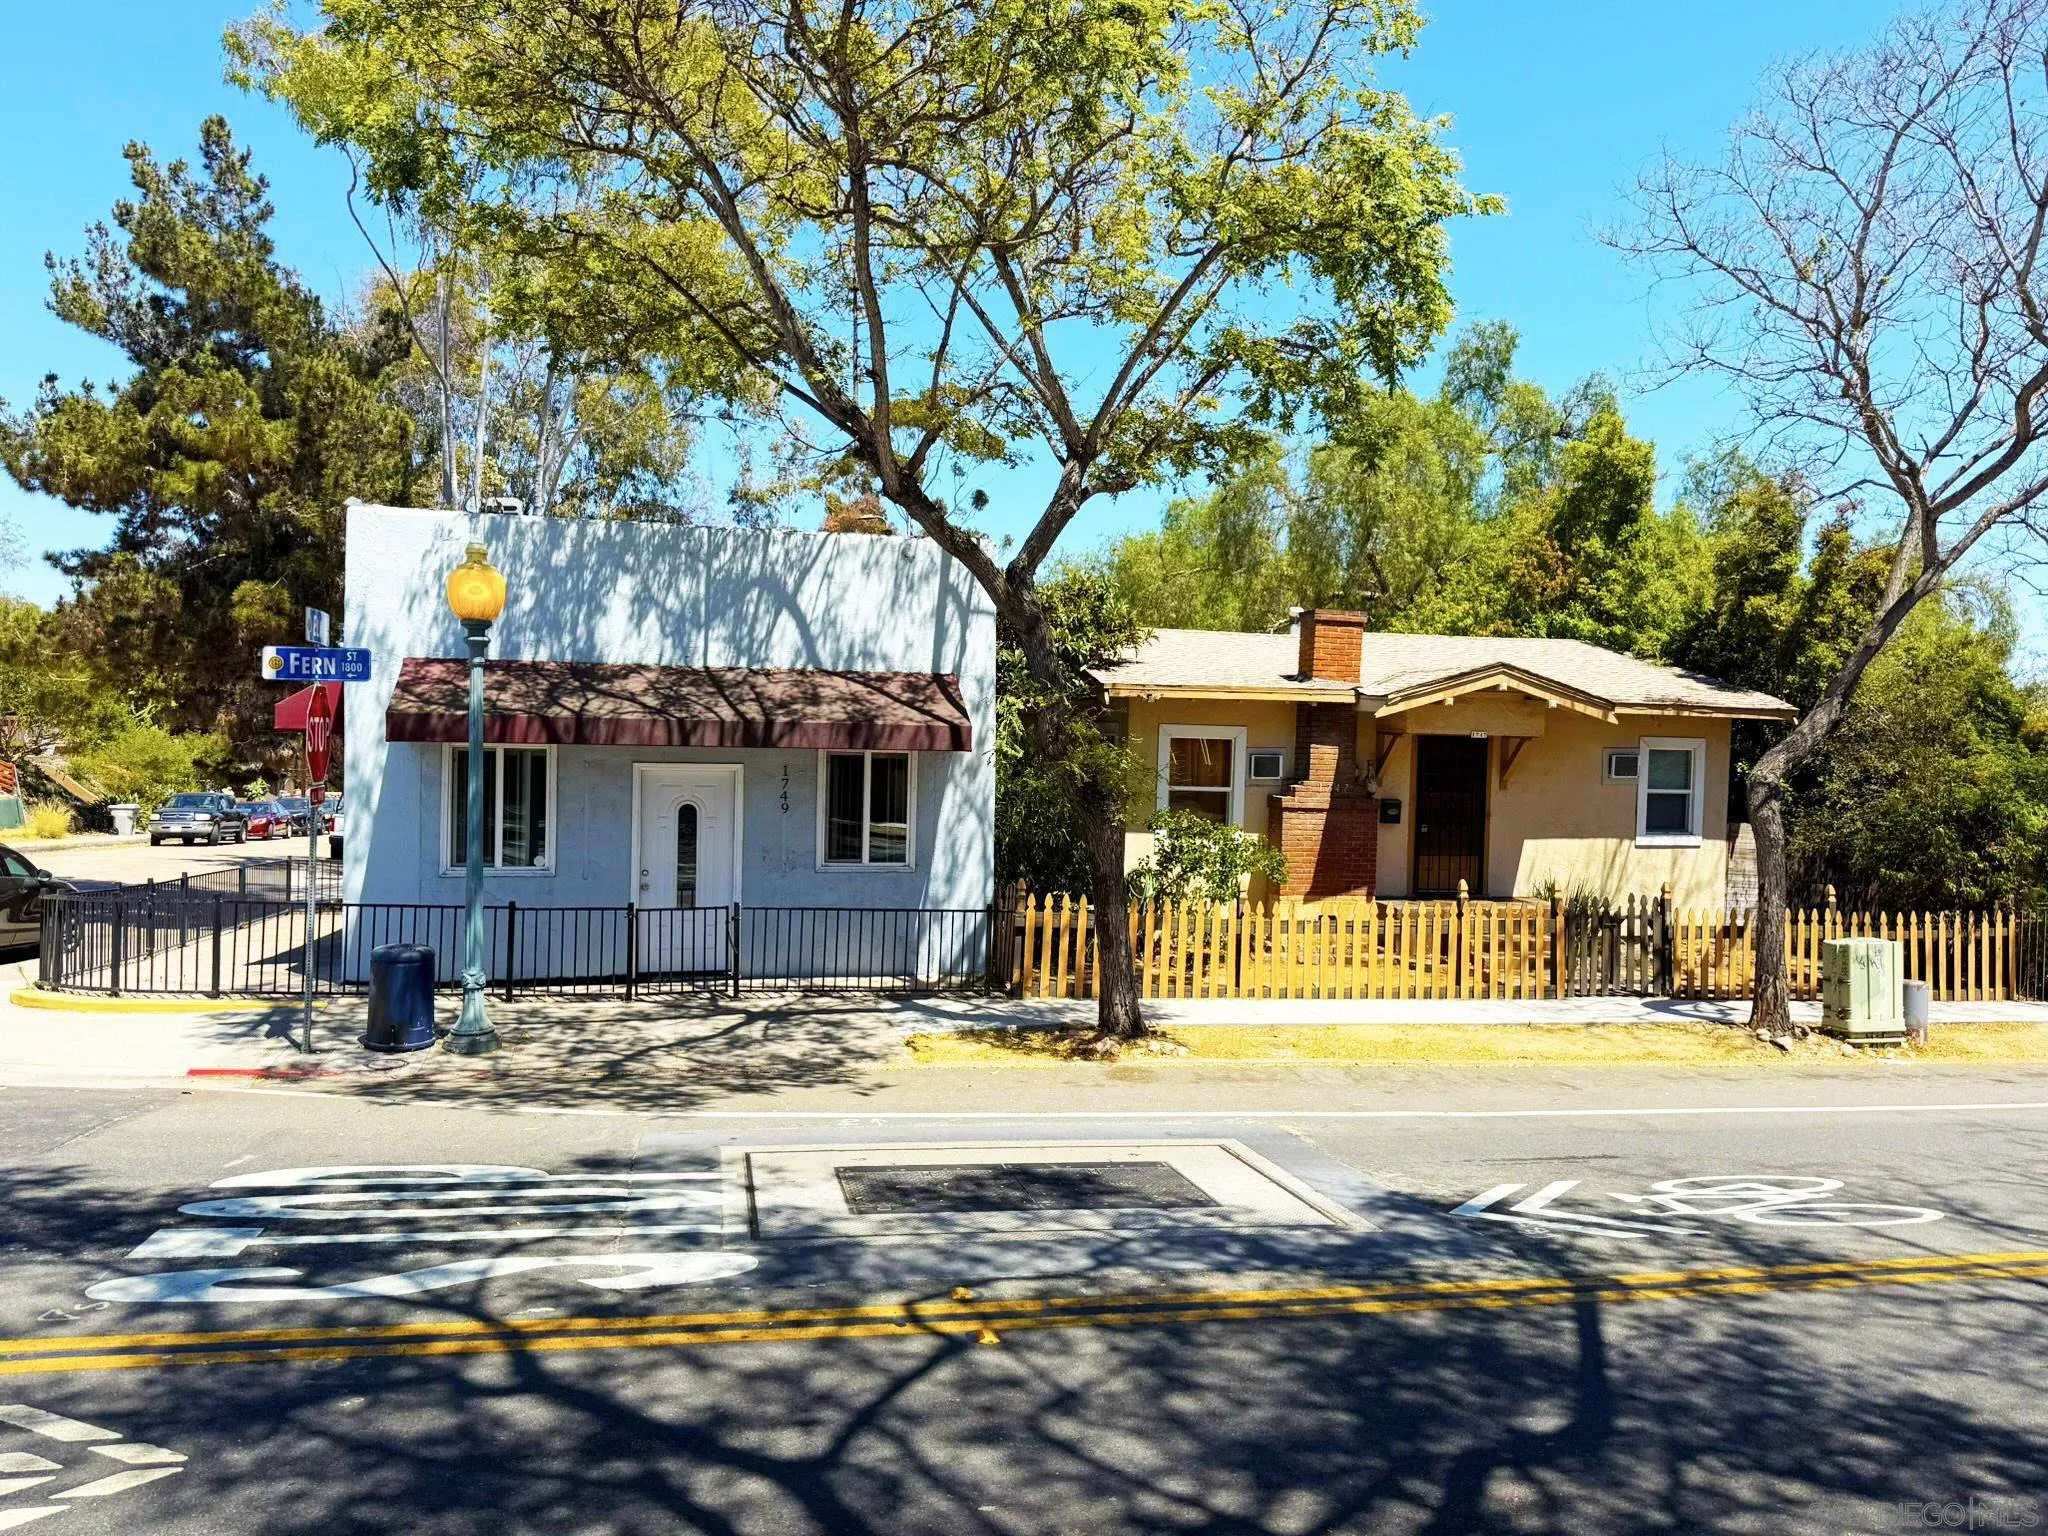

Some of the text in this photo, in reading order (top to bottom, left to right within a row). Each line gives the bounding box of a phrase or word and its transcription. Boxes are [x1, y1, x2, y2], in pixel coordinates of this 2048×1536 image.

[289, 652, 357, 674] FERN ST
[341, 662, 362, 672] 1800
[308, 717, 331, 752] STOP
[780, 765, 789, 814] 1749
[85, 1164, 759, 1303] STOP
